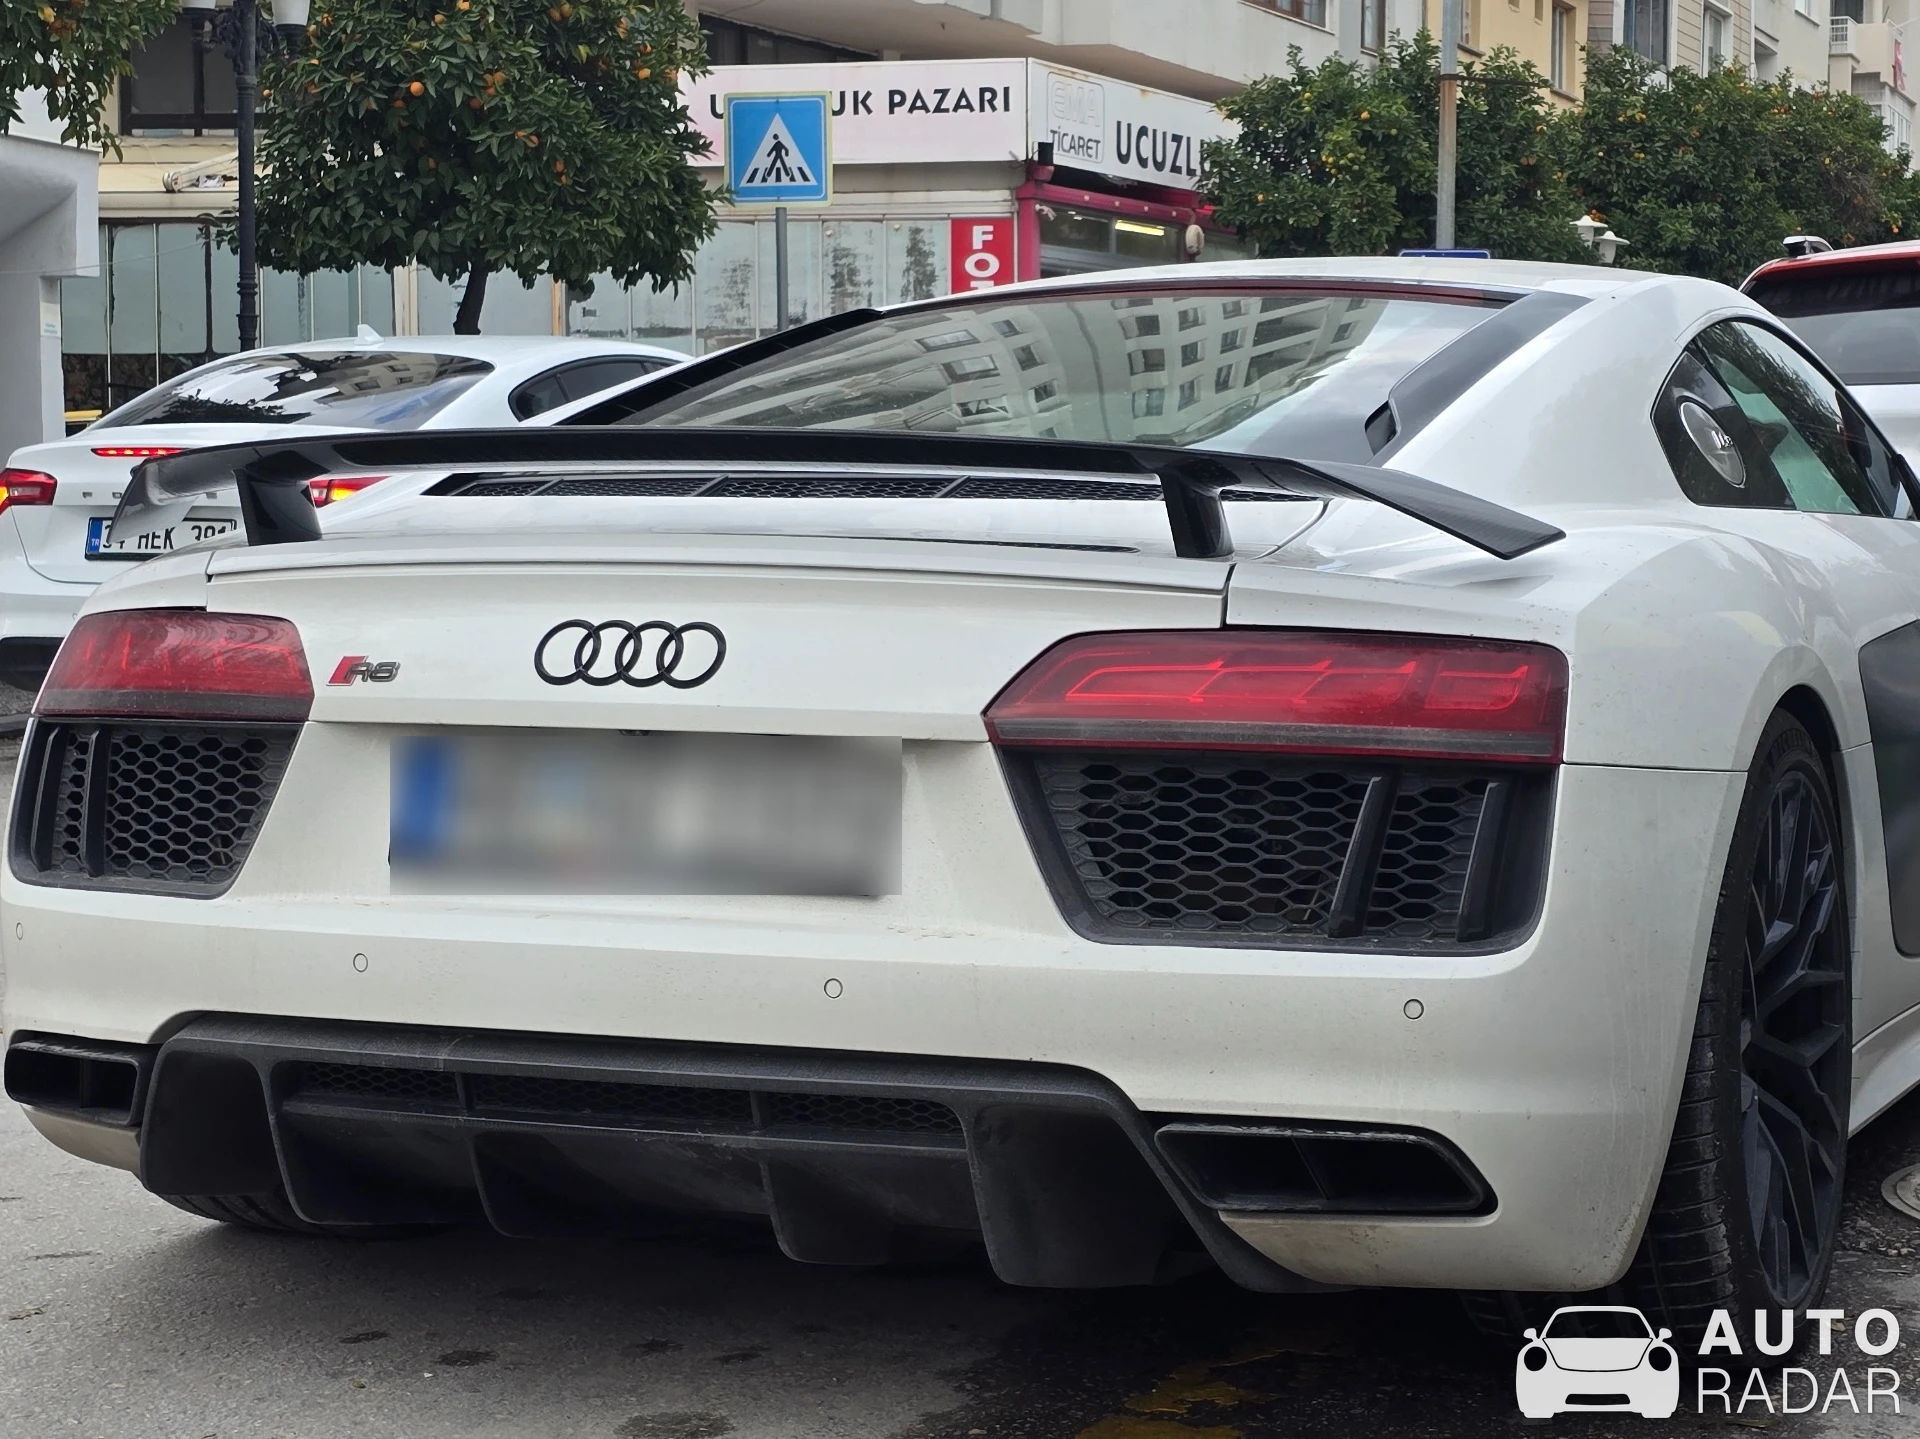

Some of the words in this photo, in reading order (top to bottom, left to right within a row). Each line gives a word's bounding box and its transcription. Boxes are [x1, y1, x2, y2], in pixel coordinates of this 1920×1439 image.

[888, 86, 1010, 115] PAZARI
[1050, 126, 1101, 160] TİCARET
[91, 538, 100, 547] TR
[342, 660, 401, 683] R8
